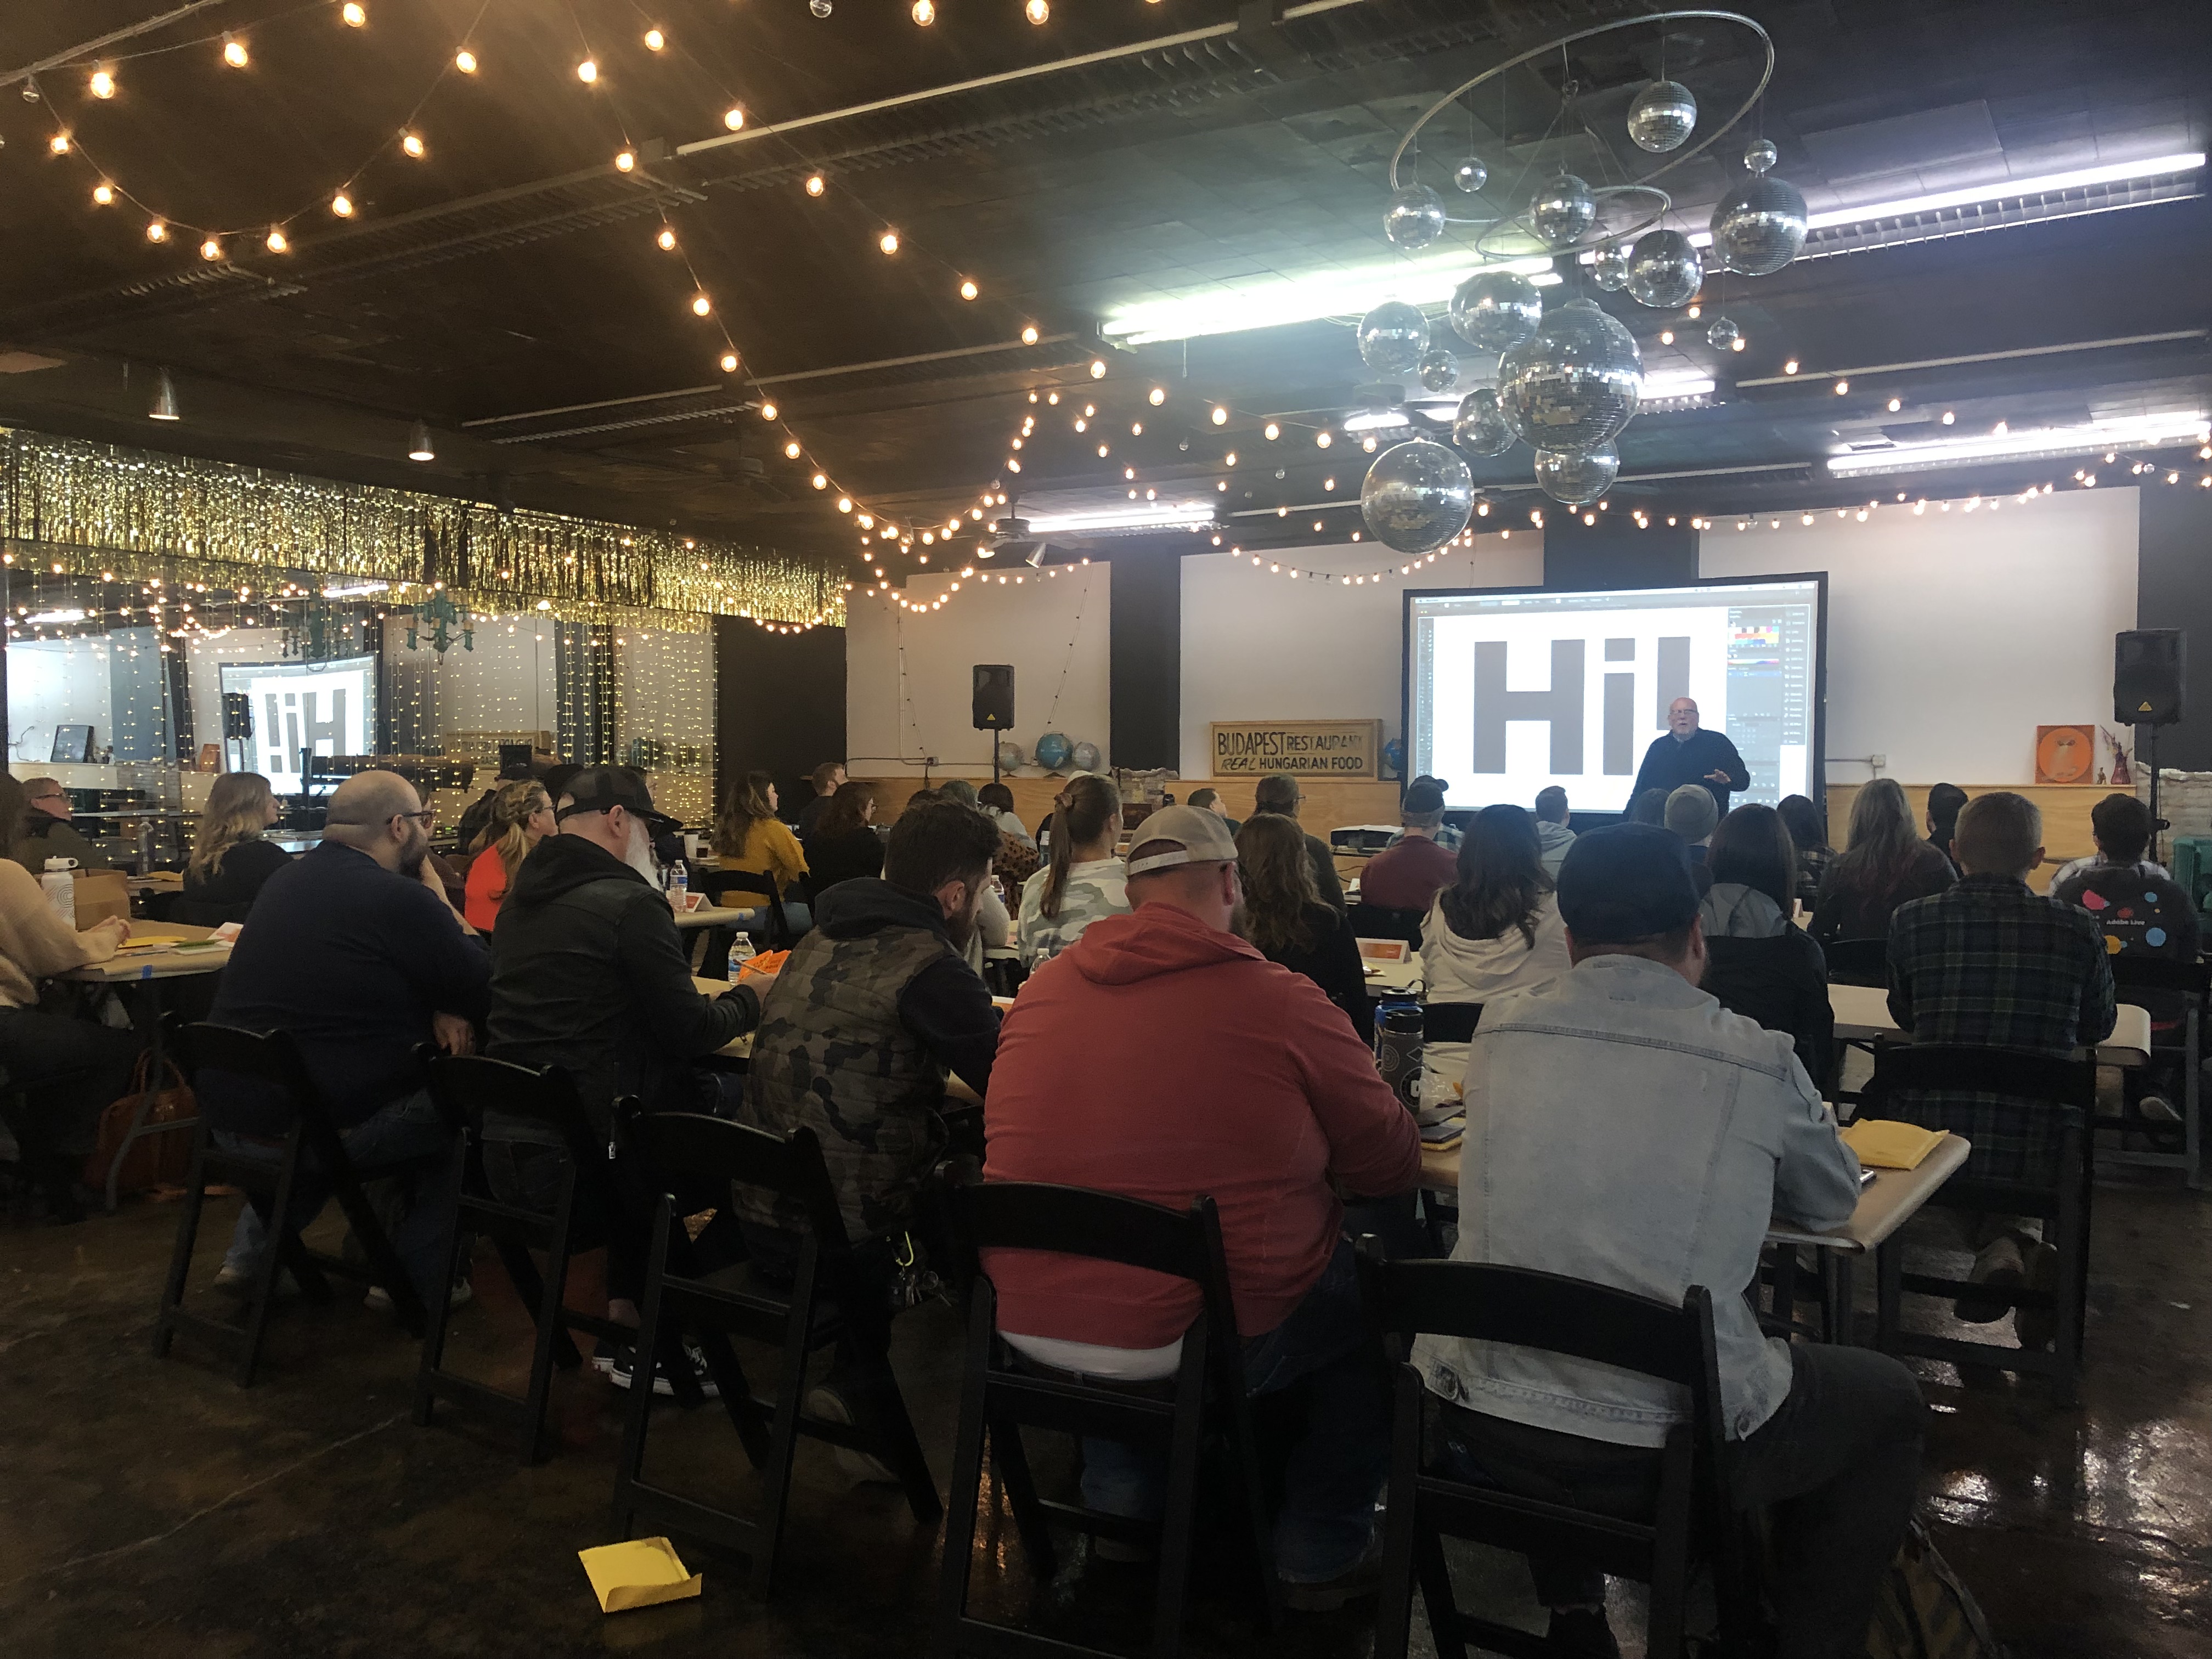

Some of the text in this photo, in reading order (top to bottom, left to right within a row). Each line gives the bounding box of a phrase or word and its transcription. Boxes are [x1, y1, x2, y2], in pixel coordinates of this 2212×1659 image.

[1217, 731, 1286, 755] BUDAPEST
[1221, 757, 1363, 770] REAL HUNGARIAN FOOD
